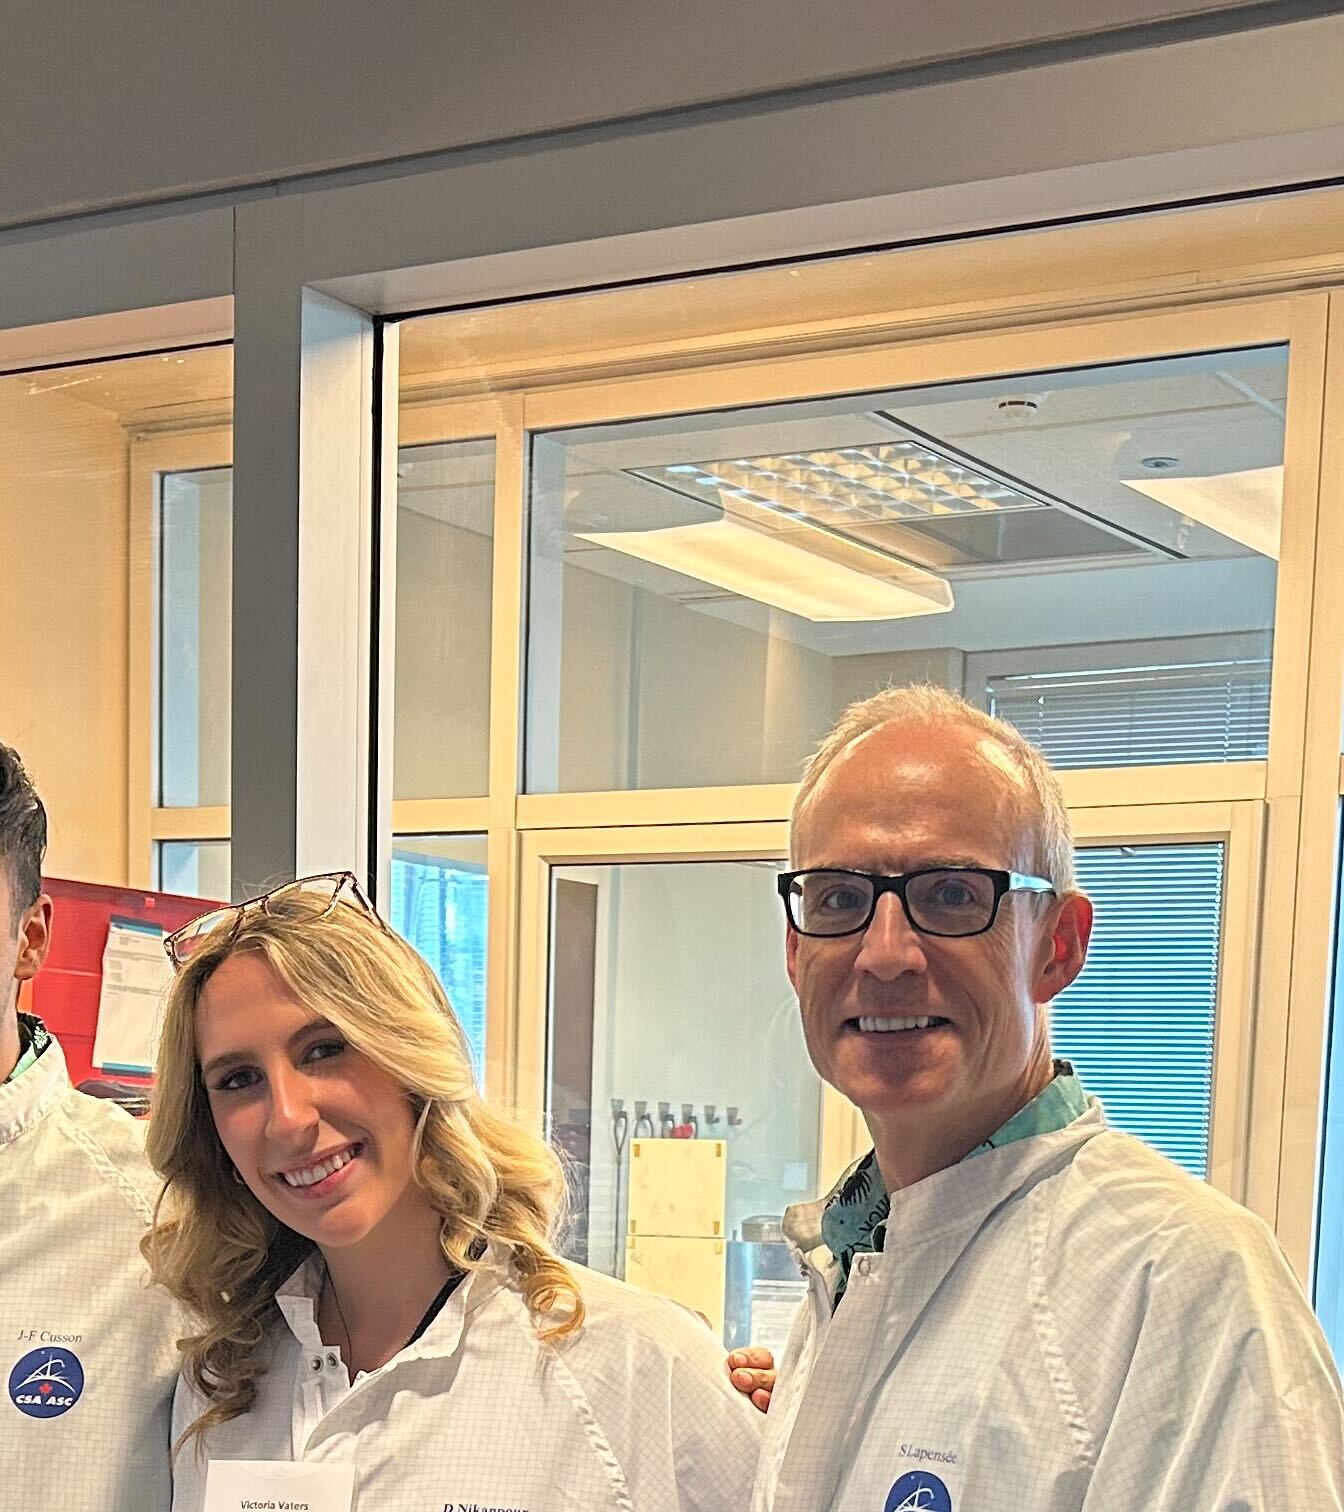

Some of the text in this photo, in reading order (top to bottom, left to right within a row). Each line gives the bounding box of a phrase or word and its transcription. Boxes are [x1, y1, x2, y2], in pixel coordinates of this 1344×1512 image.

[40, 1330, 82, 1343] Cusson
[15, 1394, 74, 1407] CSA ASC
[240, 1500, 276, 1510] Victoria
